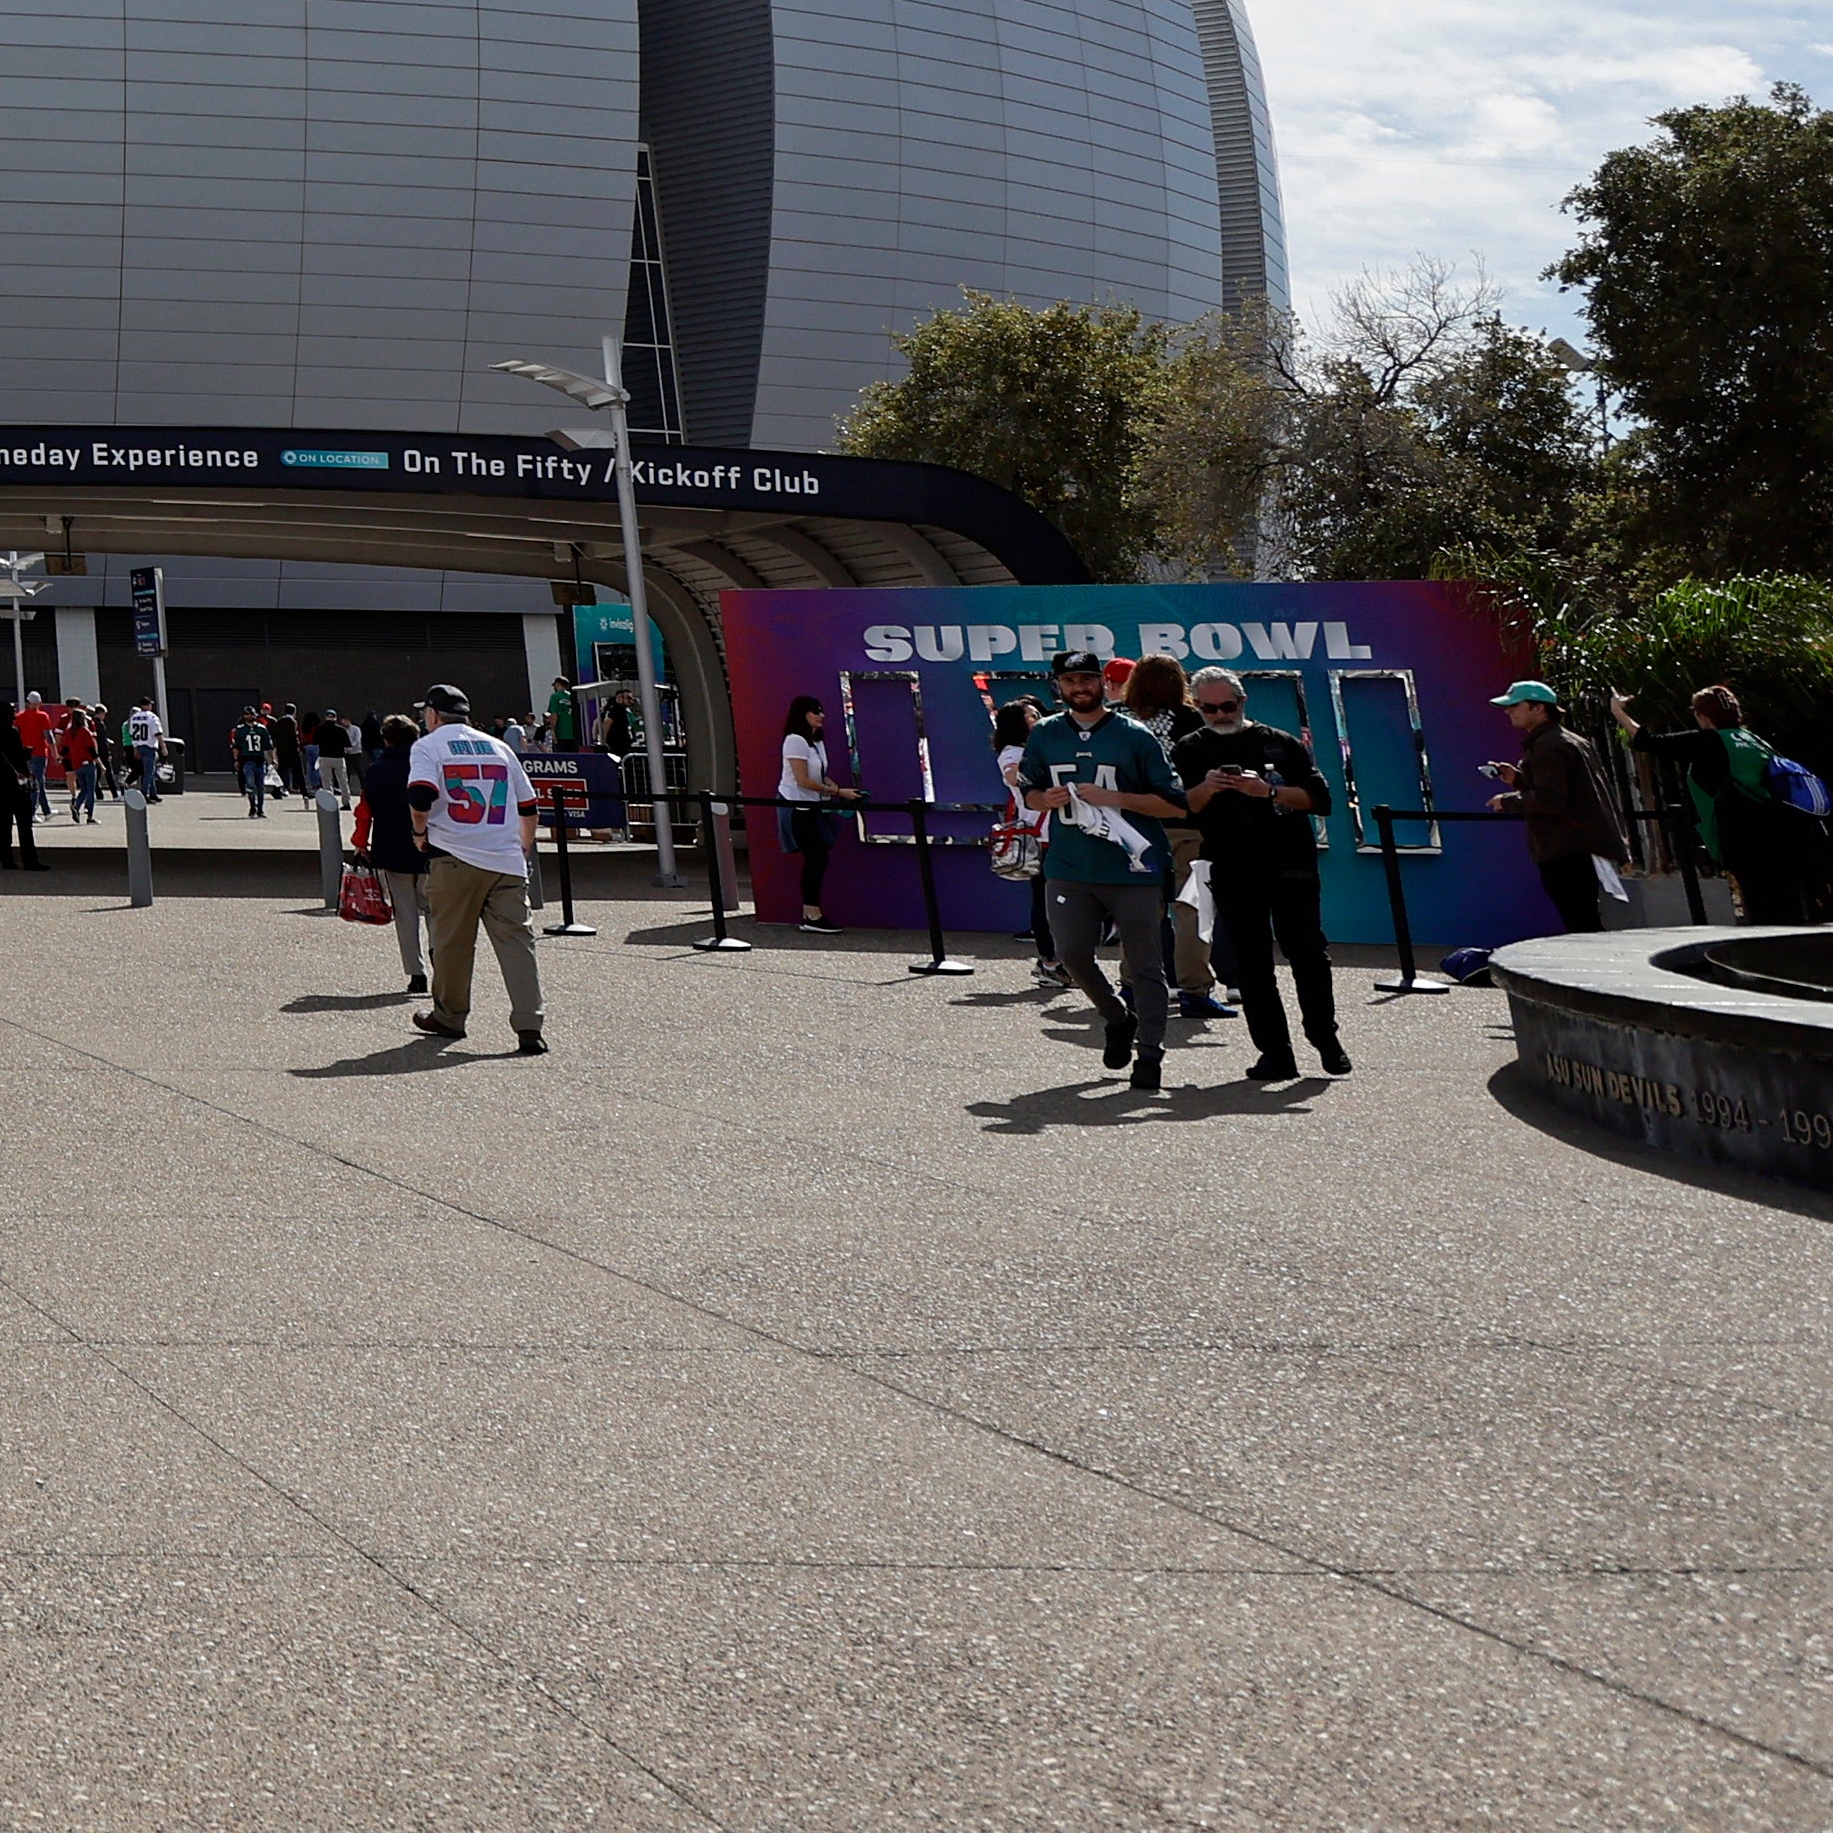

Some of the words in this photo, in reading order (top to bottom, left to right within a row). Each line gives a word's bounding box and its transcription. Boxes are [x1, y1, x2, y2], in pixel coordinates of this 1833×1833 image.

[92, 442, 260, 471] Experience
[299, 453, 316, 464] ON
[319, 454, 380, 465] LOCATION
[403, 450, 440, 474] On
[451, 451, 505, 478] The
[517, 454, 592, 486] Fifty
[629, 459, 742, 491] Kickoff
[753, 467, 820, 495] Club
[863, 623, 1115, 662] SUPER
[1139, 620, 1372, 661] BOWL
[132, 723, 149, 741] 20
[245, 734, 261, 752] 13
[523, 760, 578, 774] GRAMS
[442, 764, 509, 825] 57
[568, 810, 586, 818] VISA
[1546, 1053, 1570, 1085] ASU
[1572, 1060, 1604, 1098] SUN
[1607, 1071, 1682, 1117] DEVILS
[1691, 1089, 1751, 1132] 1994
[1780, 1108, 1833, 1150] 199
